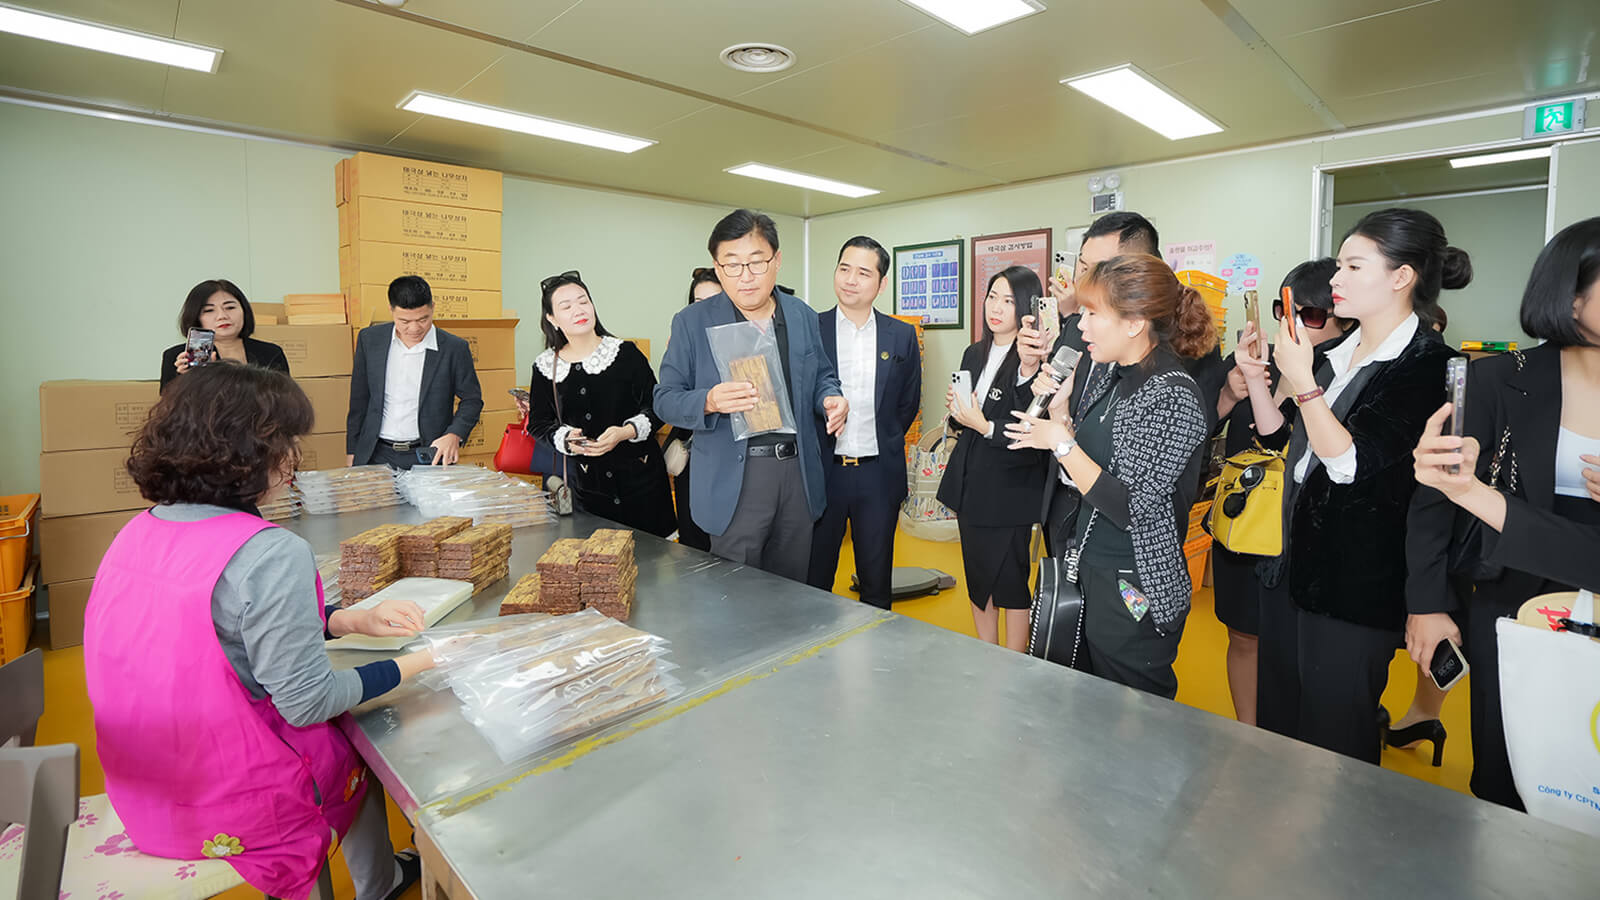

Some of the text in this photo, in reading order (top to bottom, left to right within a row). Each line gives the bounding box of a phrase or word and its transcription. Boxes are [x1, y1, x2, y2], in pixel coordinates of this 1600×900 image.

[1162, 430, 1170, 438] LE
[1157, 443, 1166, 451] LE
[1152, 456, 1160, 464] LE
[1147, 469, 1157, 478] LE
[1538, 784, 1561, 797] Công
[1563, 790, 1573, 800] ty
